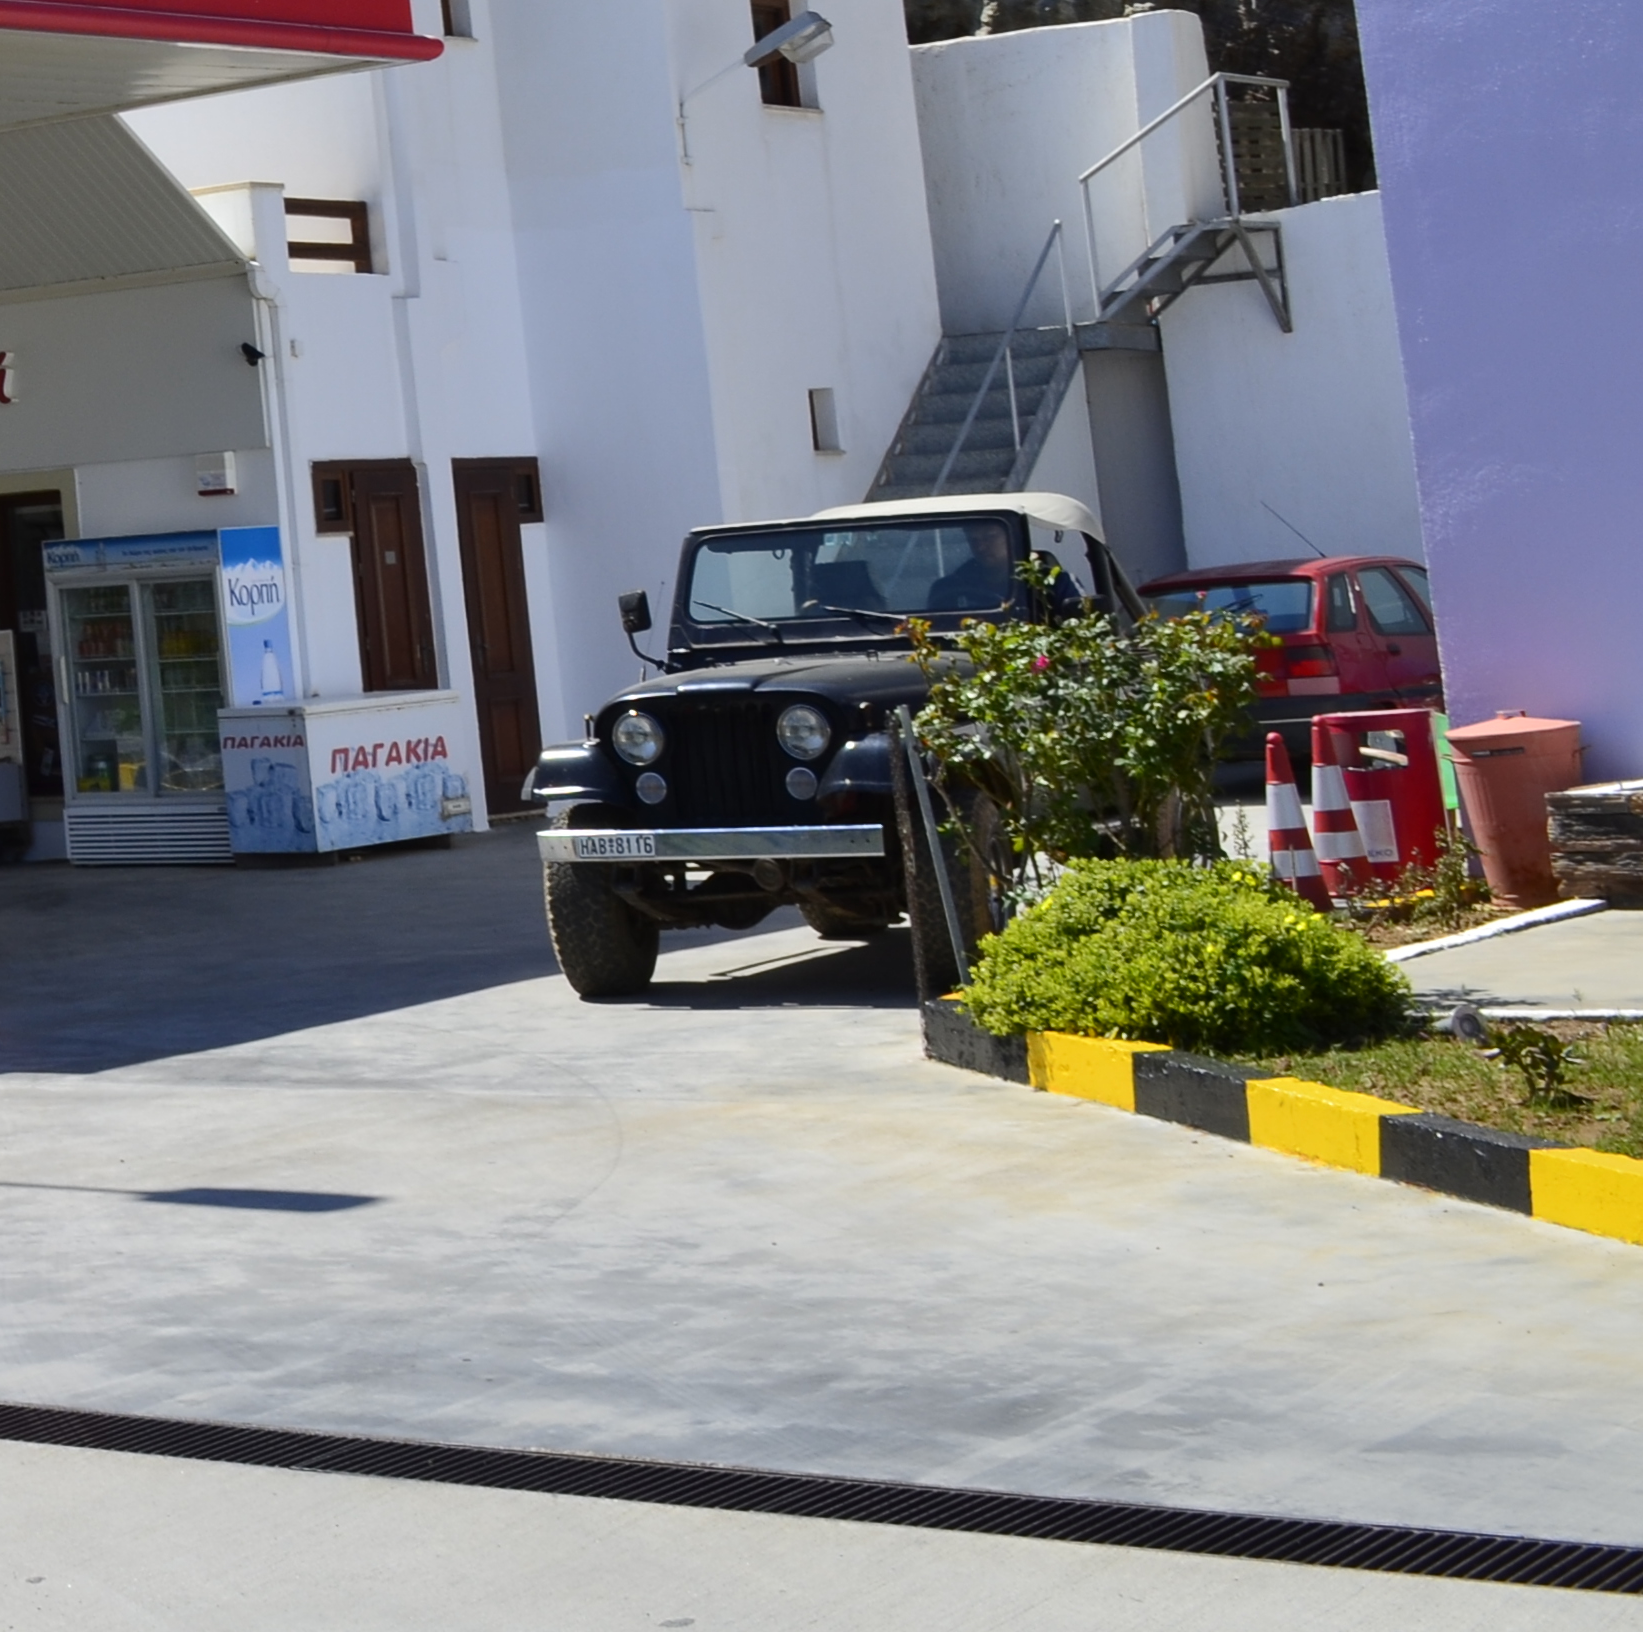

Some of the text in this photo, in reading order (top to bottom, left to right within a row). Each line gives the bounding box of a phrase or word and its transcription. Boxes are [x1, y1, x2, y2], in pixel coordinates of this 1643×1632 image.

[228, 576, 280, 615] Κορπή
[223, 734, 305, 750] ΠΑΓΑΚΙΑ
[331, 735, 448, 774] ΠΑΓΑΚΙΑ
